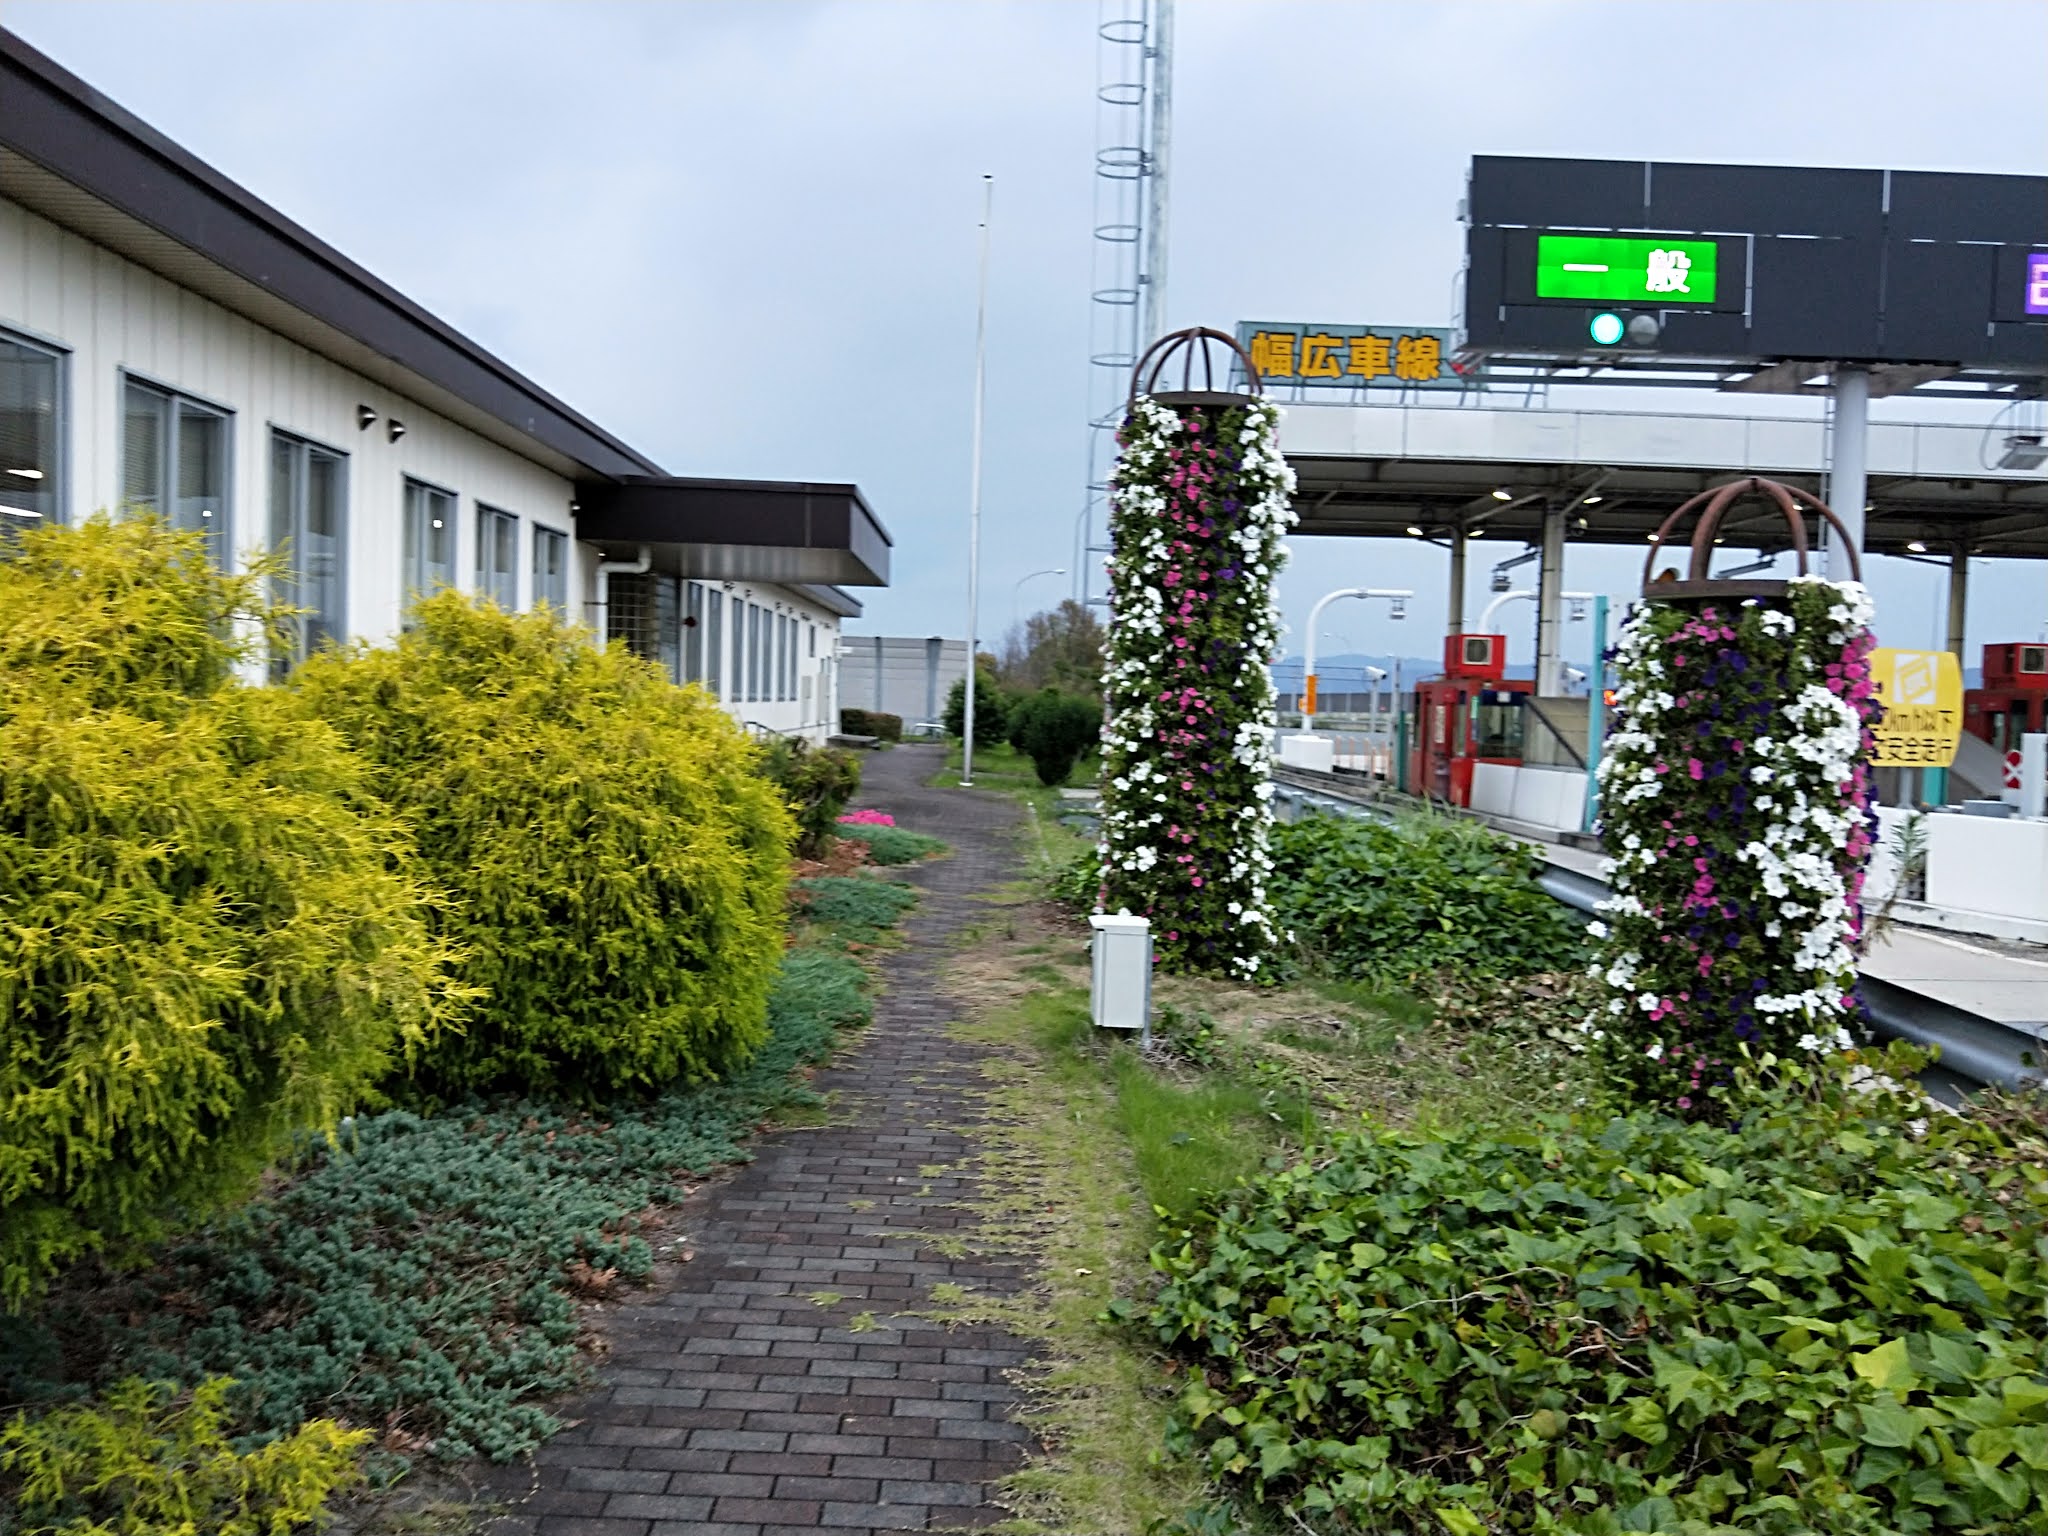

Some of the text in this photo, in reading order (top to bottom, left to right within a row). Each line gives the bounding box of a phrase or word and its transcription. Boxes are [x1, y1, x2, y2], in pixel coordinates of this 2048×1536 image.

[1562, 248, 1692, 294] 一般
[1250, 331, 1442, 381] 幅広車線
